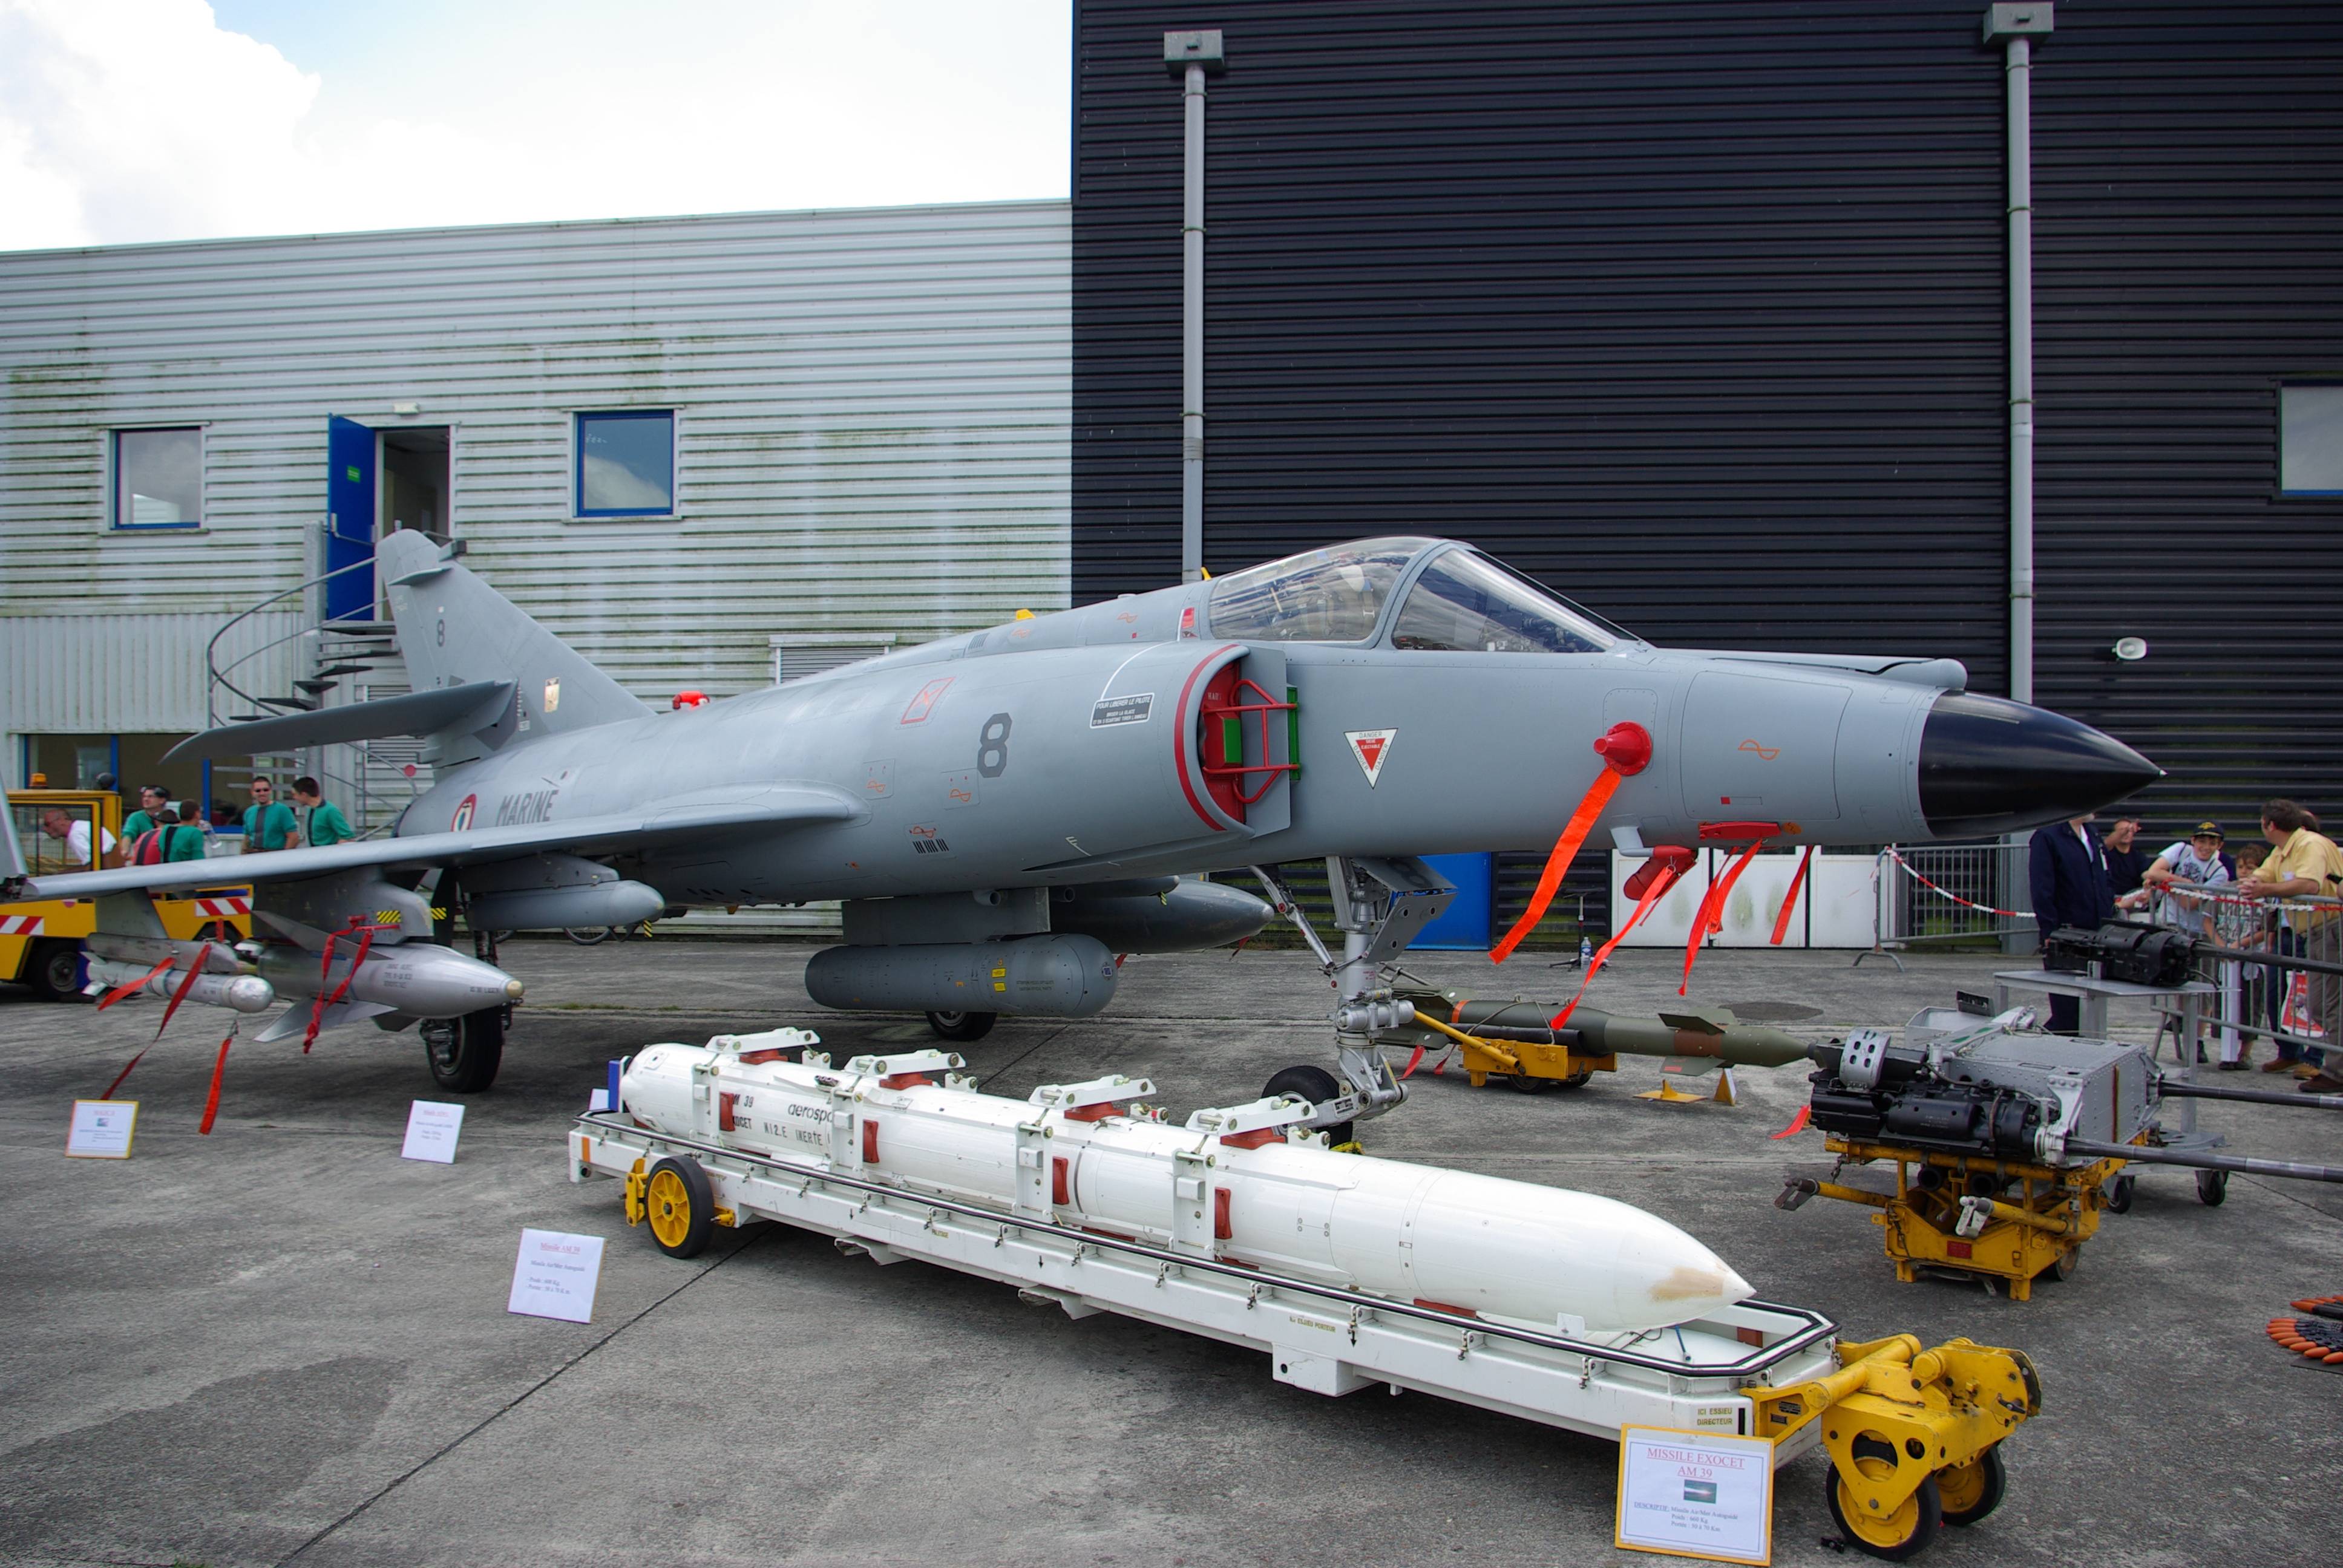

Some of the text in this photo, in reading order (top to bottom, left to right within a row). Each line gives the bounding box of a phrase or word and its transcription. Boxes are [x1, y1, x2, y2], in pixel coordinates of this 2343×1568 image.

[437, 618, 445, 648] 8
[1096, 701, 1110, 710] POUR
[1135, 696, 1152, 704] PILOTE
[976, 712, 1012, 779] 8
[1353, 745, 1369, 771] DANGER
[1374, 743, 1389, 770] DANGER
[494, 789, 560, 827] MARINE
[732, 1093, 755, 1108] M 39
[795, 1129, 824, 1146] INERTE
[1314, 1321, 1336, 1333] PORTEUR
[1709, 1407, 1733, 1416] ESSIEU
[1697, 1417, 1733, 1426] DIRECTEUR
[1647, 1447, 1746, 1469] MISSILE EXOCET
[1677, 1465, 1713, 1478] AM 39
